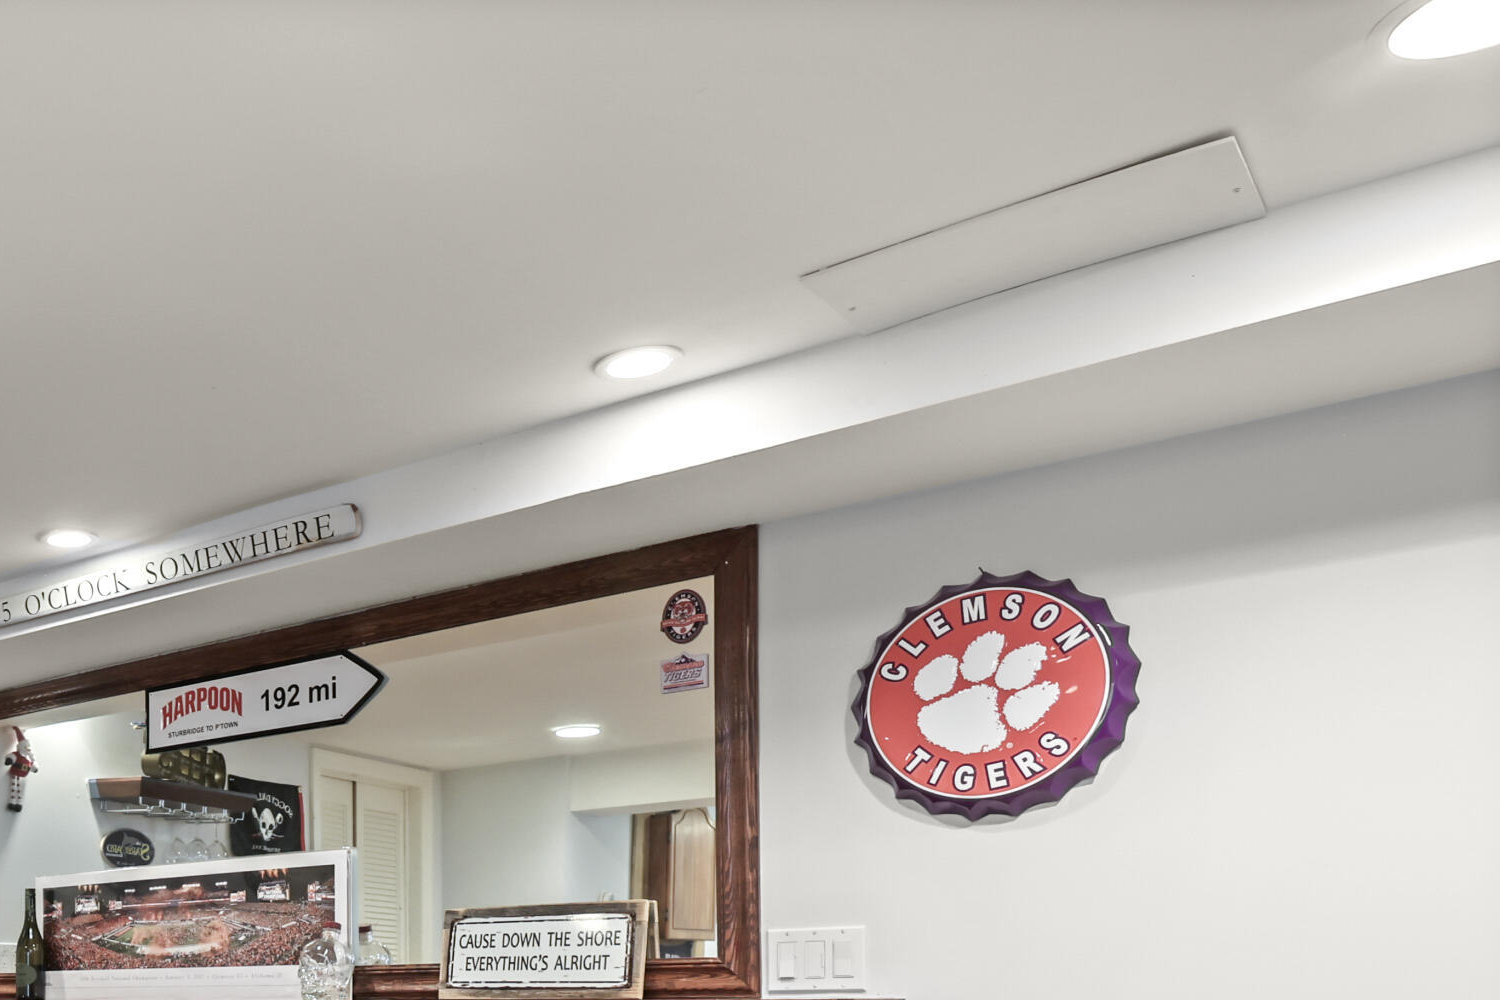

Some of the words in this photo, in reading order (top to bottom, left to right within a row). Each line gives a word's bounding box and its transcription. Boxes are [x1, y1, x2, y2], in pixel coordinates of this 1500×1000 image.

[2, 602, 12, 622] 5
[25, 569, 131, 616] O'CLOCK
[145, 513, 335, 585] SOMEWHERE
[879, 592, 1093, 683] CLEMSON
[161, 685, 243, 730] HARPOON
[260, 684, 300, 712] 192
[308, 676, 337, 704] mi
[168, 725, 204, 738] STURBRIDGE
[206, 723, 214, 732] TO
[903, 731, 1072, 793] TIGERS
[458, 932, 497, 949] CAUSE
[501, 931, 541, 948] DOWN
[547, 930, 571, 946] THE
[577, 930, 622, 947] SHORE
[465, 953, 549, 971] EVERYTHING'S
[554, 954, 611, 971] ALRIGHT
